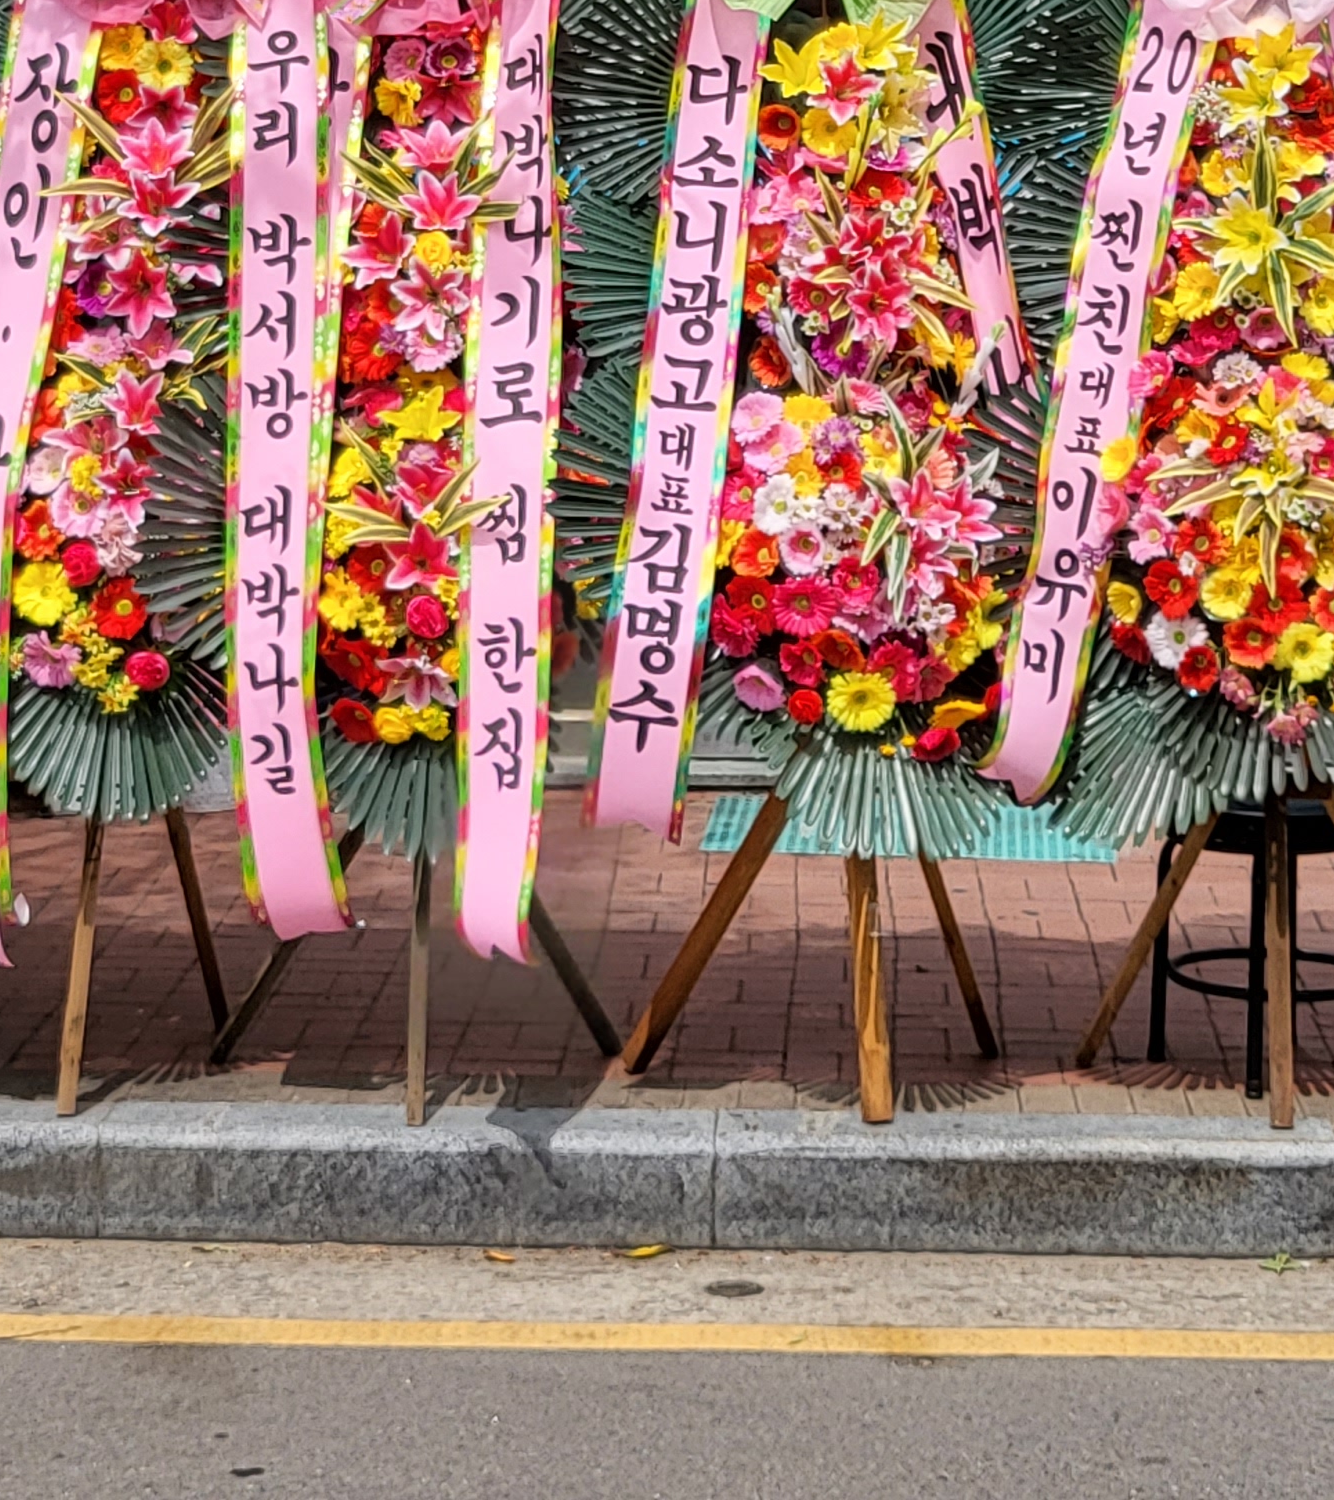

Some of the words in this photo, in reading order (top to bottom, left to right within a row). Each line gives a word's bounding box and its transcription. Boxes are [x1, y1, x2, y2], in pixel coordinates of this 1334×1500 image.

[4, 43, 78, 270] 장인
[247, 30, 310, 167] 우리
[245, 213, 312, 440] 박서방
